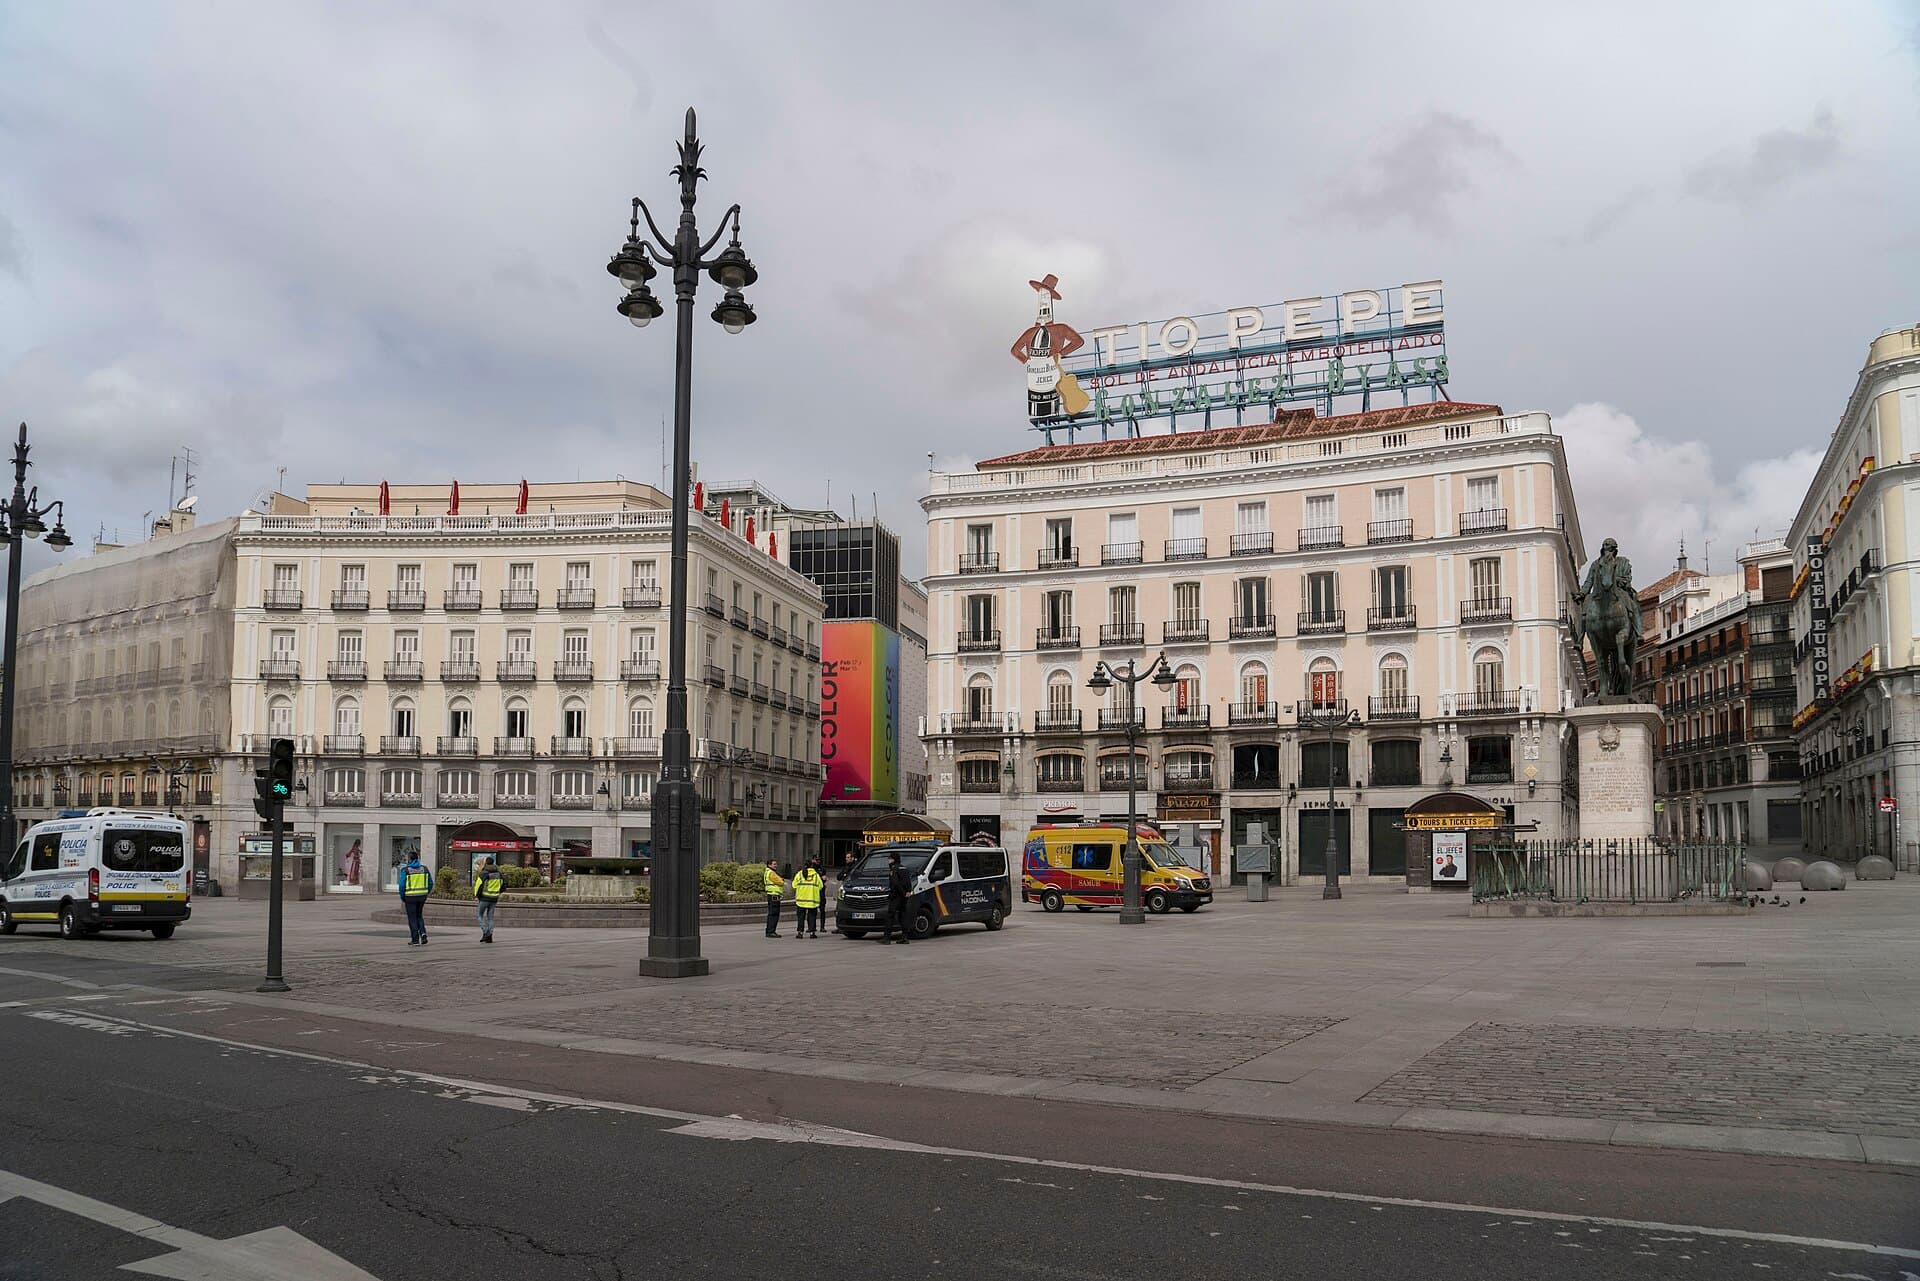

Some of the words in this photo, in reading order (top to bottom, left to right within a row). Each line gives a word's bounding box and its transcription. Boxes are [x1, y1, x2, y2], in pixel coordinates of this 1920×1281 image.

[1092, 316, 1200, 366] TIO
[1227, 280, 1444, 349] PEPE
[1089, 376, 1128, 390] SOL
[1135, 369, 1159, 383] DE
[1168, 353, 1278, 380] ANDALUCIA
[1287, 333, 1443, 364] EMBOTELLADO
[1094, 374, 1288, 421] GONZALEZ
[1328, 354, 1449, 394] BYASS
[1808, 544, 1825, 609] HOTEL
[1813, 619, 1828, 699] EUROPA
[1168, 798, 1208, 808] PALAZZO
[1419, 818, 1440, 826] TOURS
[1449, 817, 1477, 826] TICKETS
[961, 896, 989, 904] NACIONAL
